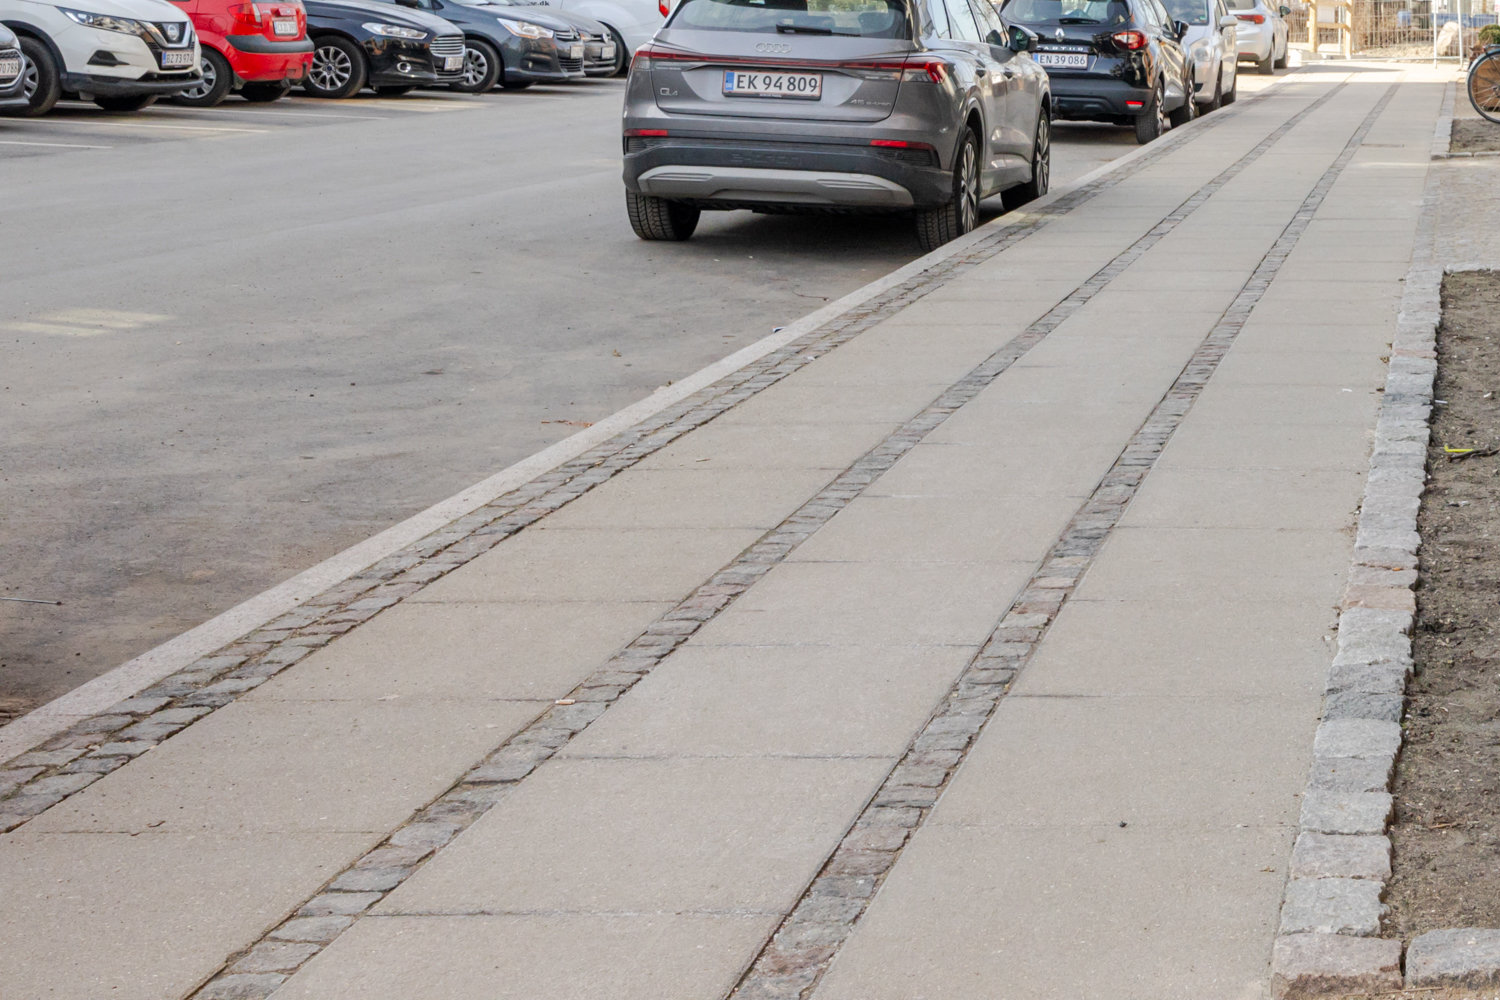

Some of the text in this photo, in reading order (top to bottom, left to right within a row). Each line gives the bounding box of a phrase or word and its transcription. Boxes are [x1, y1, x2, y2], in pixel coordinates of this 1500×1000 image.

[1040, 55, 1086, 65] EN 39 086
[736, 74, 818, 93] EK 94 809
